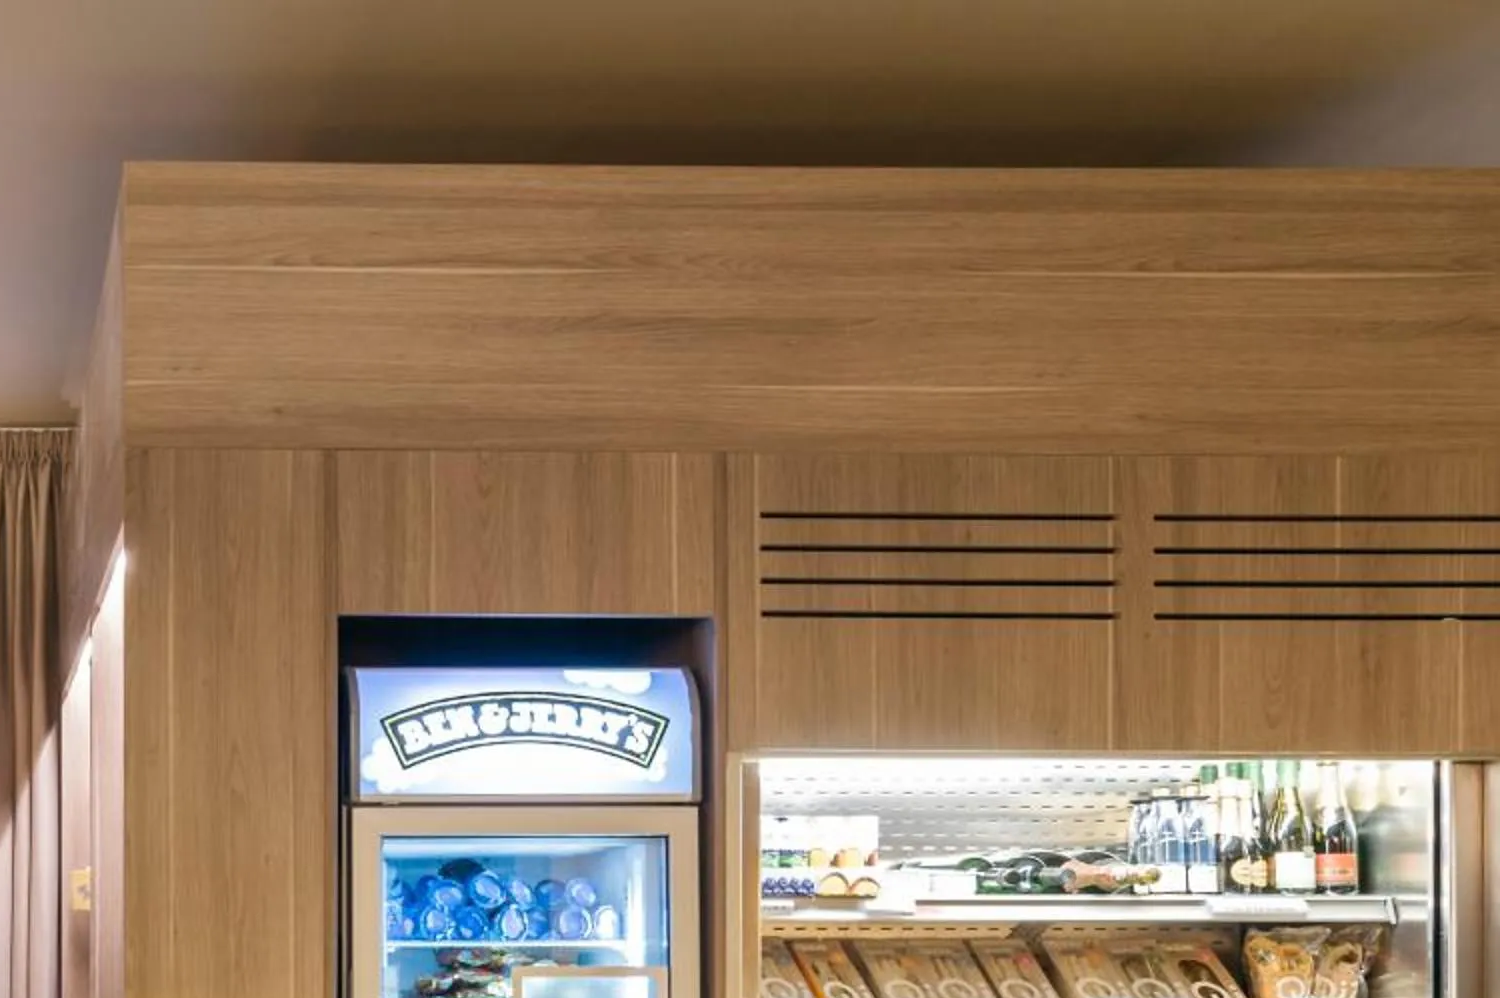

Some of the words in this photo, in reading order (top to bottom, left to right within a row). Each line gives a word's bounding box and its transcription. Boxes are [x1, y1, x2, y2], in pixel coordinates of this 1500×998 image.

[398, 703, 481, 756] BEN
[479, 702, 511, 737] &
[510, 702, 657, 758] JERRY'S
